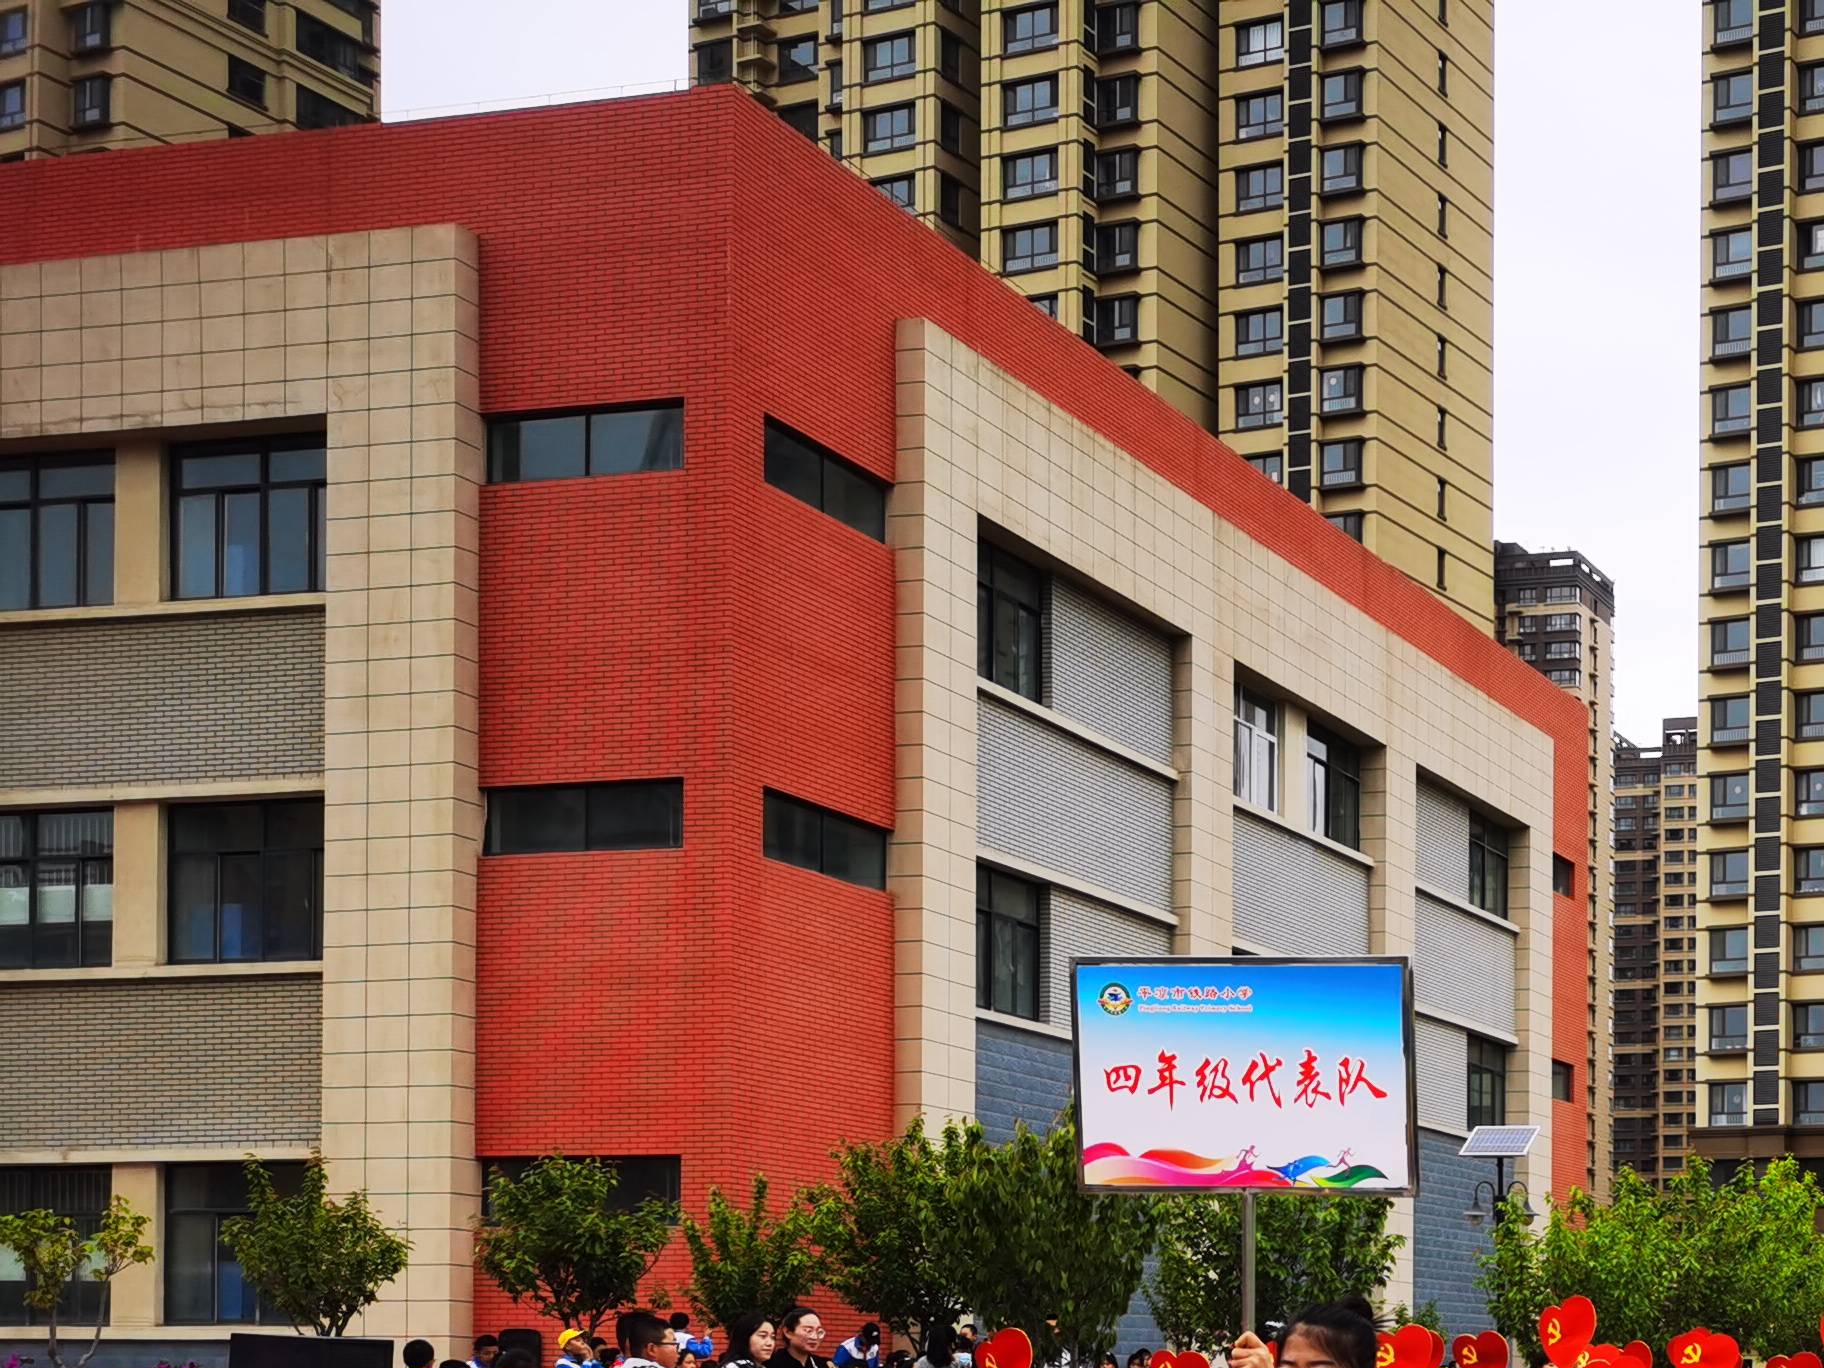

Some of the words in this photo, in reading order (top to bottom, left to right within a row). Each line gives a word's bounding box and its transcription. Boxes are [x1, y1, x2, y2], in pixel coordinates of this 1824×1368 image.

[1103, 1049, 1388, 1111] 四年级代表队
